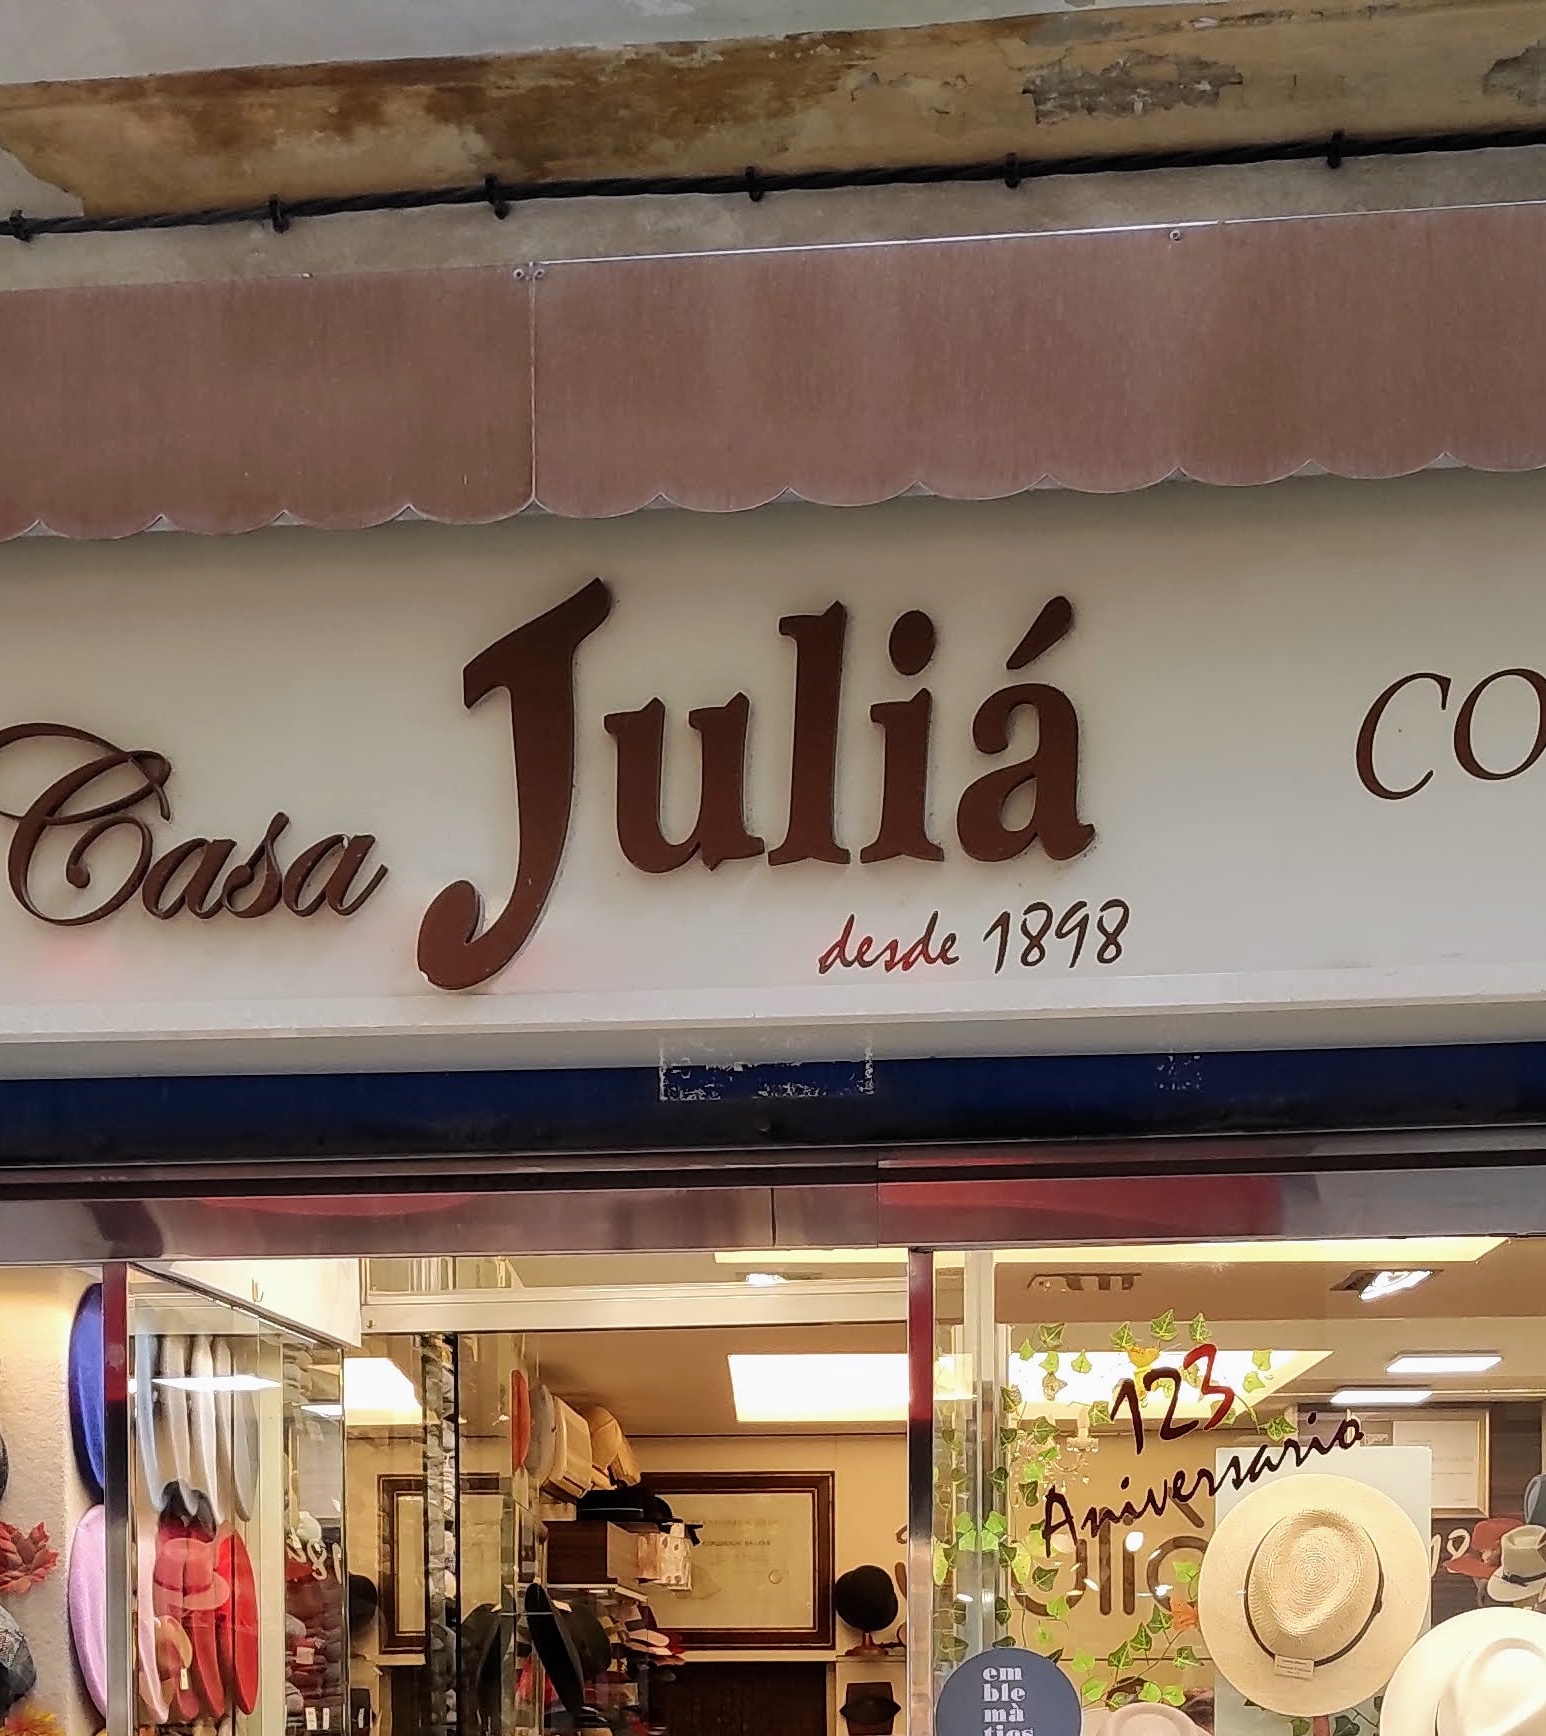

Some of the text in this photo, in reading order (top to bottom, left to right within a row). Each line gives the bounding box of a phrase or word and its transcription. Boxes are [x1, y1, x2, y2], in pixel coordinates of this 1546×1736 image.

[417, 577, 1097, 991] Juliá
[817, 899, 1131, 975] desde 1898
[1110, 1343, 1235, 1455] 123
[1040, 1411, 1365, 1558] Aniversario
[982, 1666, 1023, 1681] em
[982, 1683, 1026, 1702] ble
[983, 1702, 1025, 1723] mà
